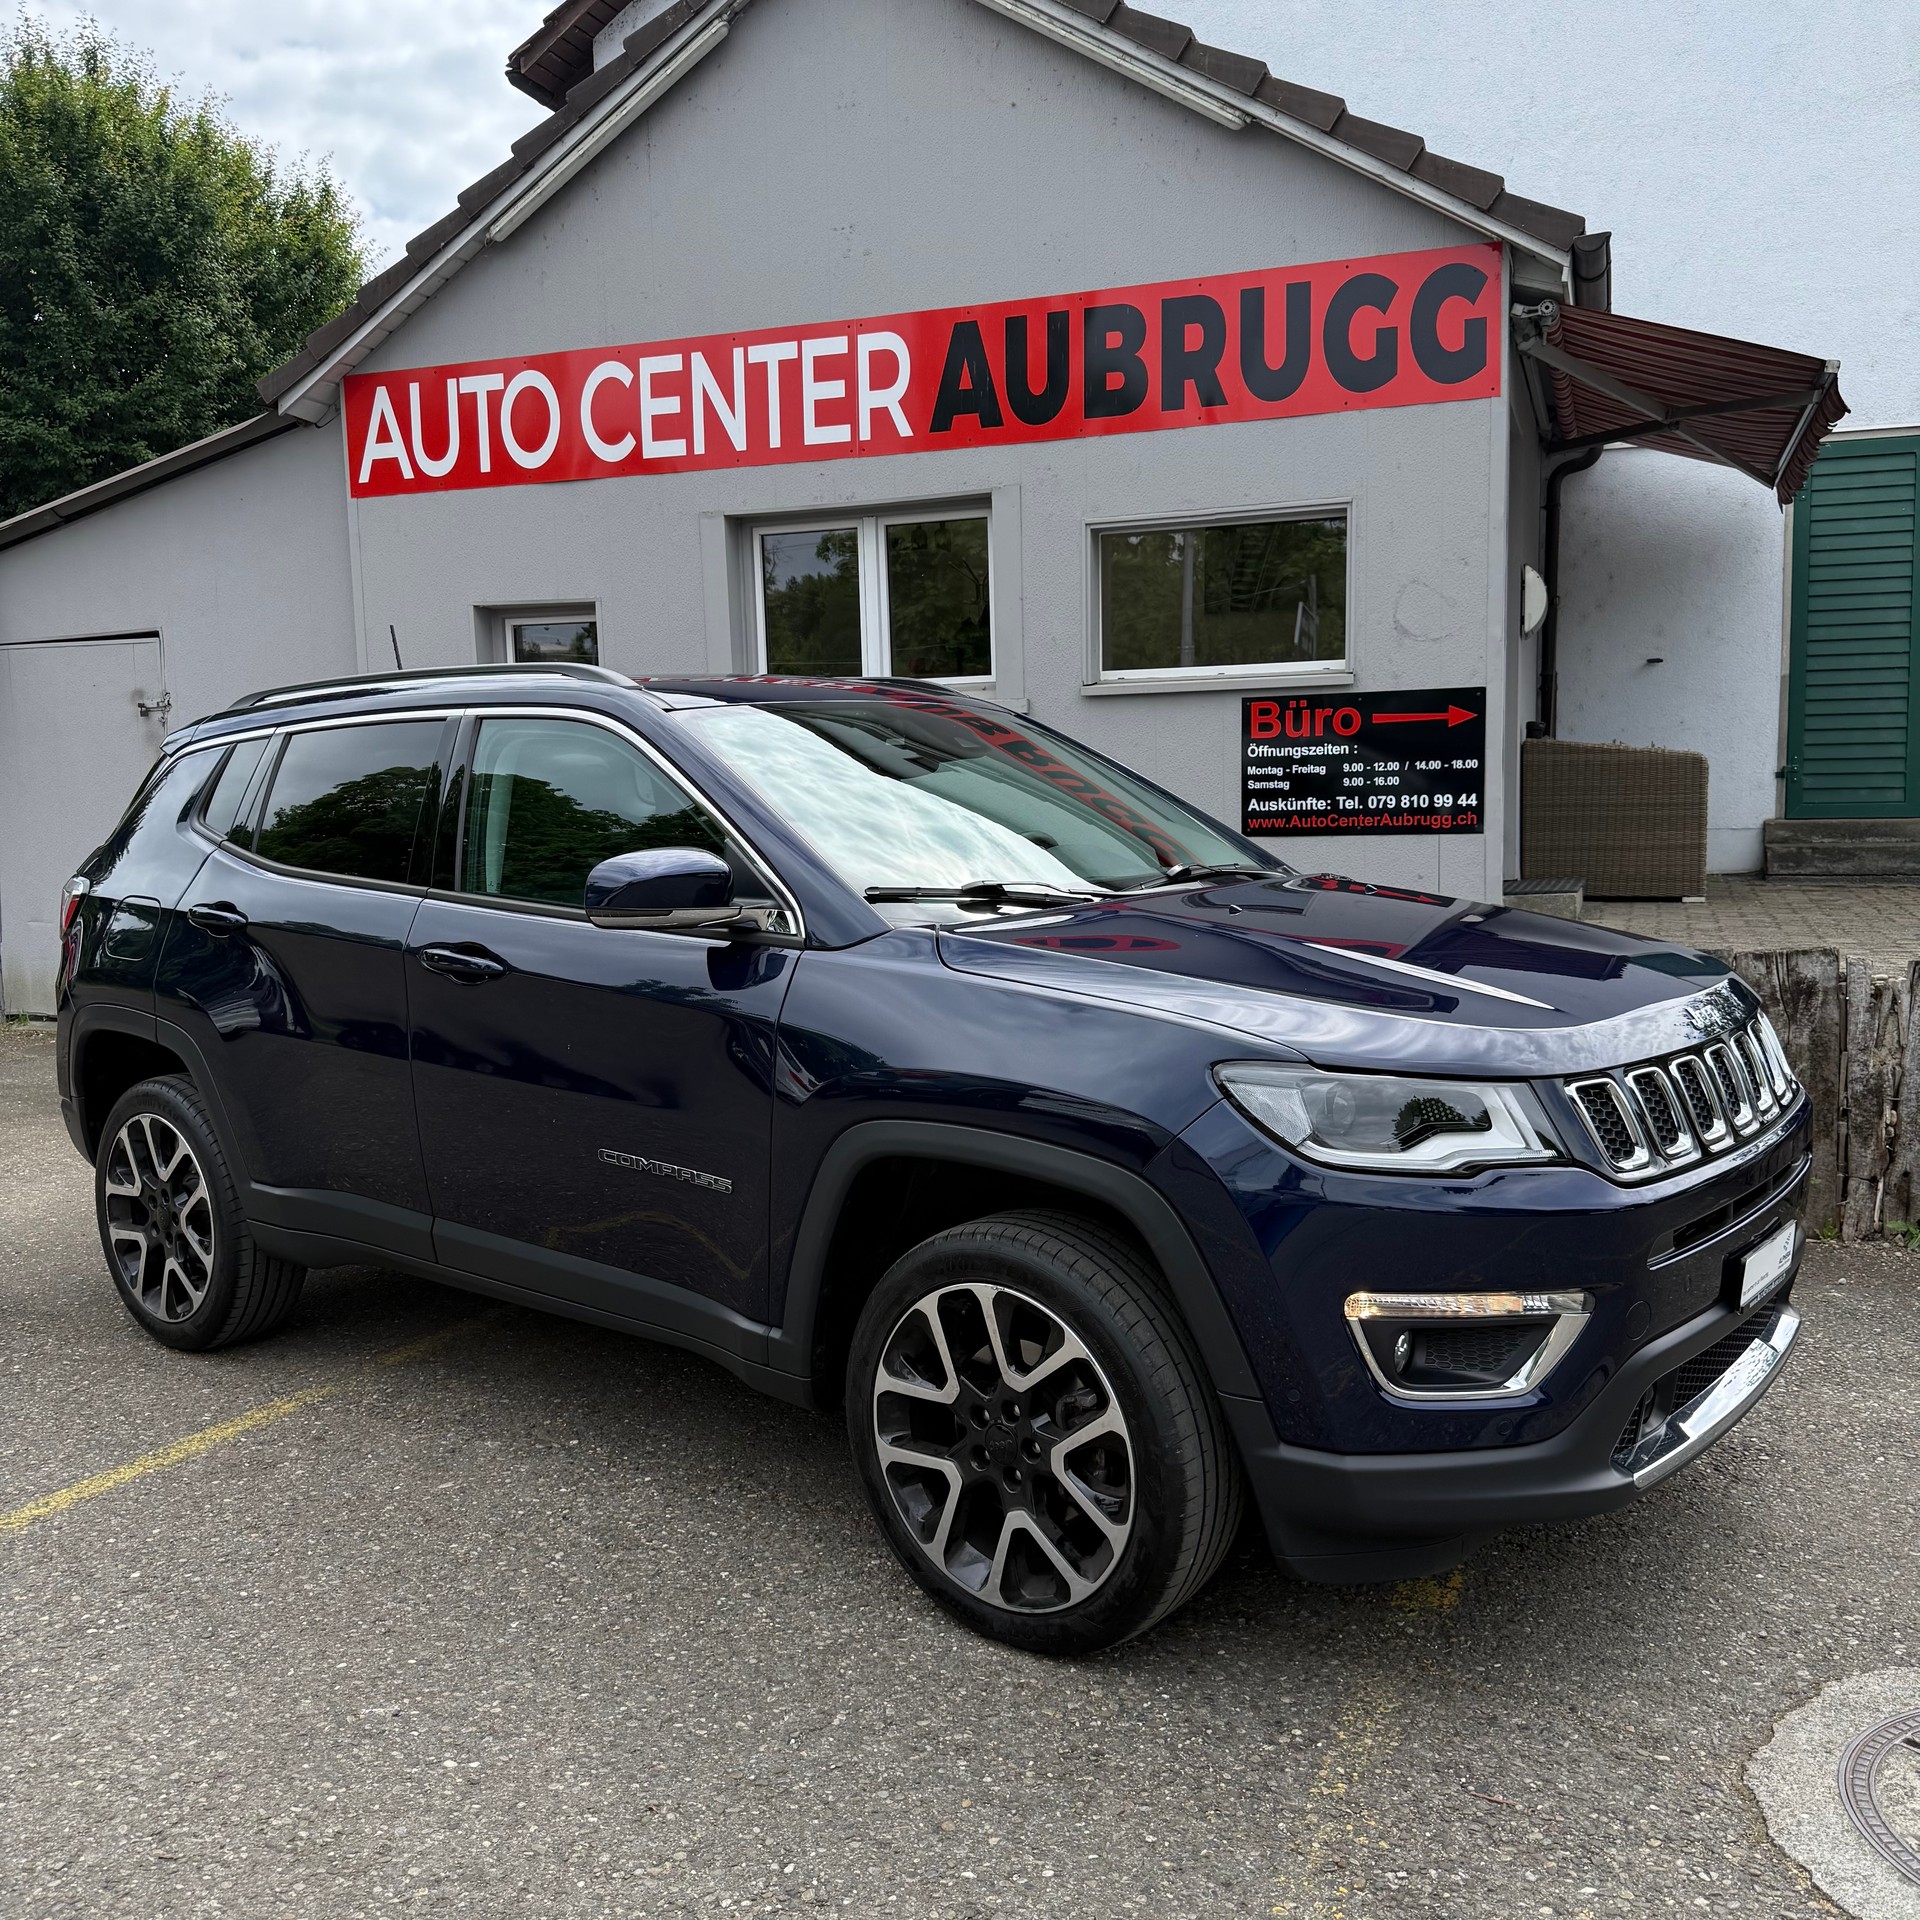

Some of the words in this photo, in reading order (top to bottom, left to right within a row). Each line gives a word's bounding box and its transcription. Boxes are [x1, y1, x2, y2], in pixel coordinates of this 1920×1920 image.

[359, 370, 561, 484] AUTO
[580, 331, 914, 463] CENTER
[929, 262, 1491, 433] AUBRUGG
[1250, 700, 1362, 739] Büro
[1247, 743, 1349, 759] Öffnungszeiten
[1247, 765, 1284, 777] Montag
[1292, 764, 1327, 776] Freitag
[1342, 762, 1364, 773] 9.00
[1373, 761, 1400, 772] 12.00
[1414, 760, 1442, 770] 14.00
[1451, 759, 1479, 769] 18.00
[1247, 780, 1290, 791] Samstag
[1342, 777, 1364, 787] 9.00
[1373, 776, 1400, 786] 16.00
[1247, 797, 1332, 812] Auskünfte:
[1336, 796, 1364, 810] Tel.
[1367, 796, 1396, 809] 079
[1401, 795, 1429, 808] 810
[1433, 794, 1453, 807] 99
[1457, 793, 1478, 807] 44
[1248, 811, 1478, 829] www.AutoCenterAubrugg.ch
[598, 1148, 732, 1194] COMPASS
